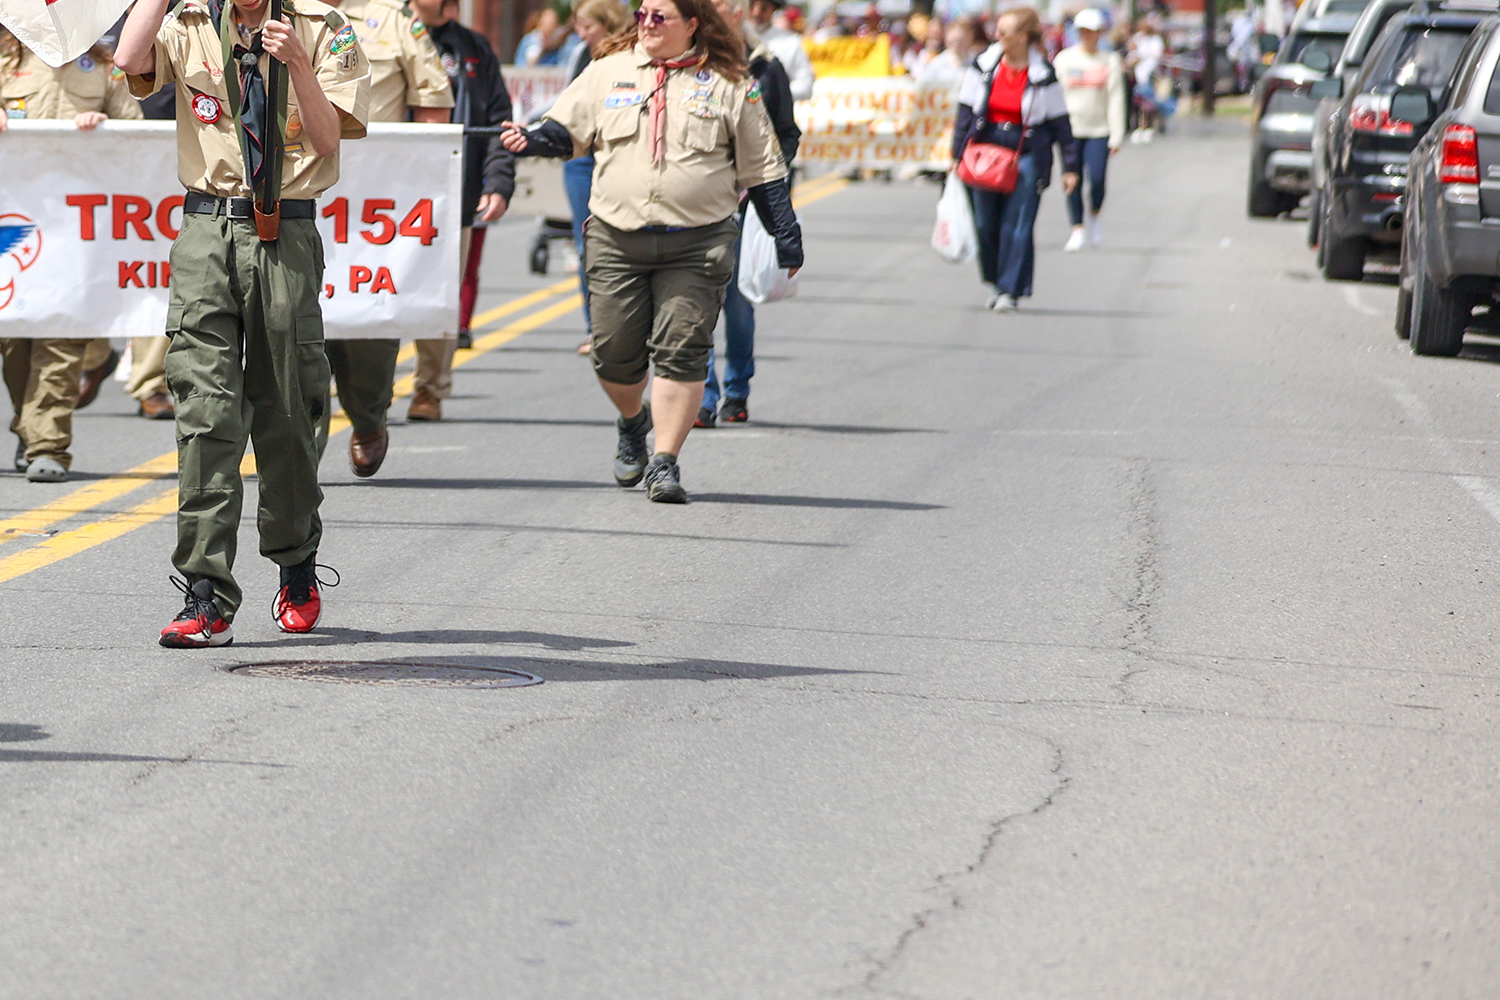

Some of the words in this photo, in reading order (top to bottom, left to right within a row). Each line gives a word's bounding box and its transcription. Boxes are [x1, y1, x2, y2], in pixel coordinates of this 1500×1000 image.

[66, 194, 185, 241] TRO
[322, 196, 438, 246] 154
[349, 265, 397, 294] PA
